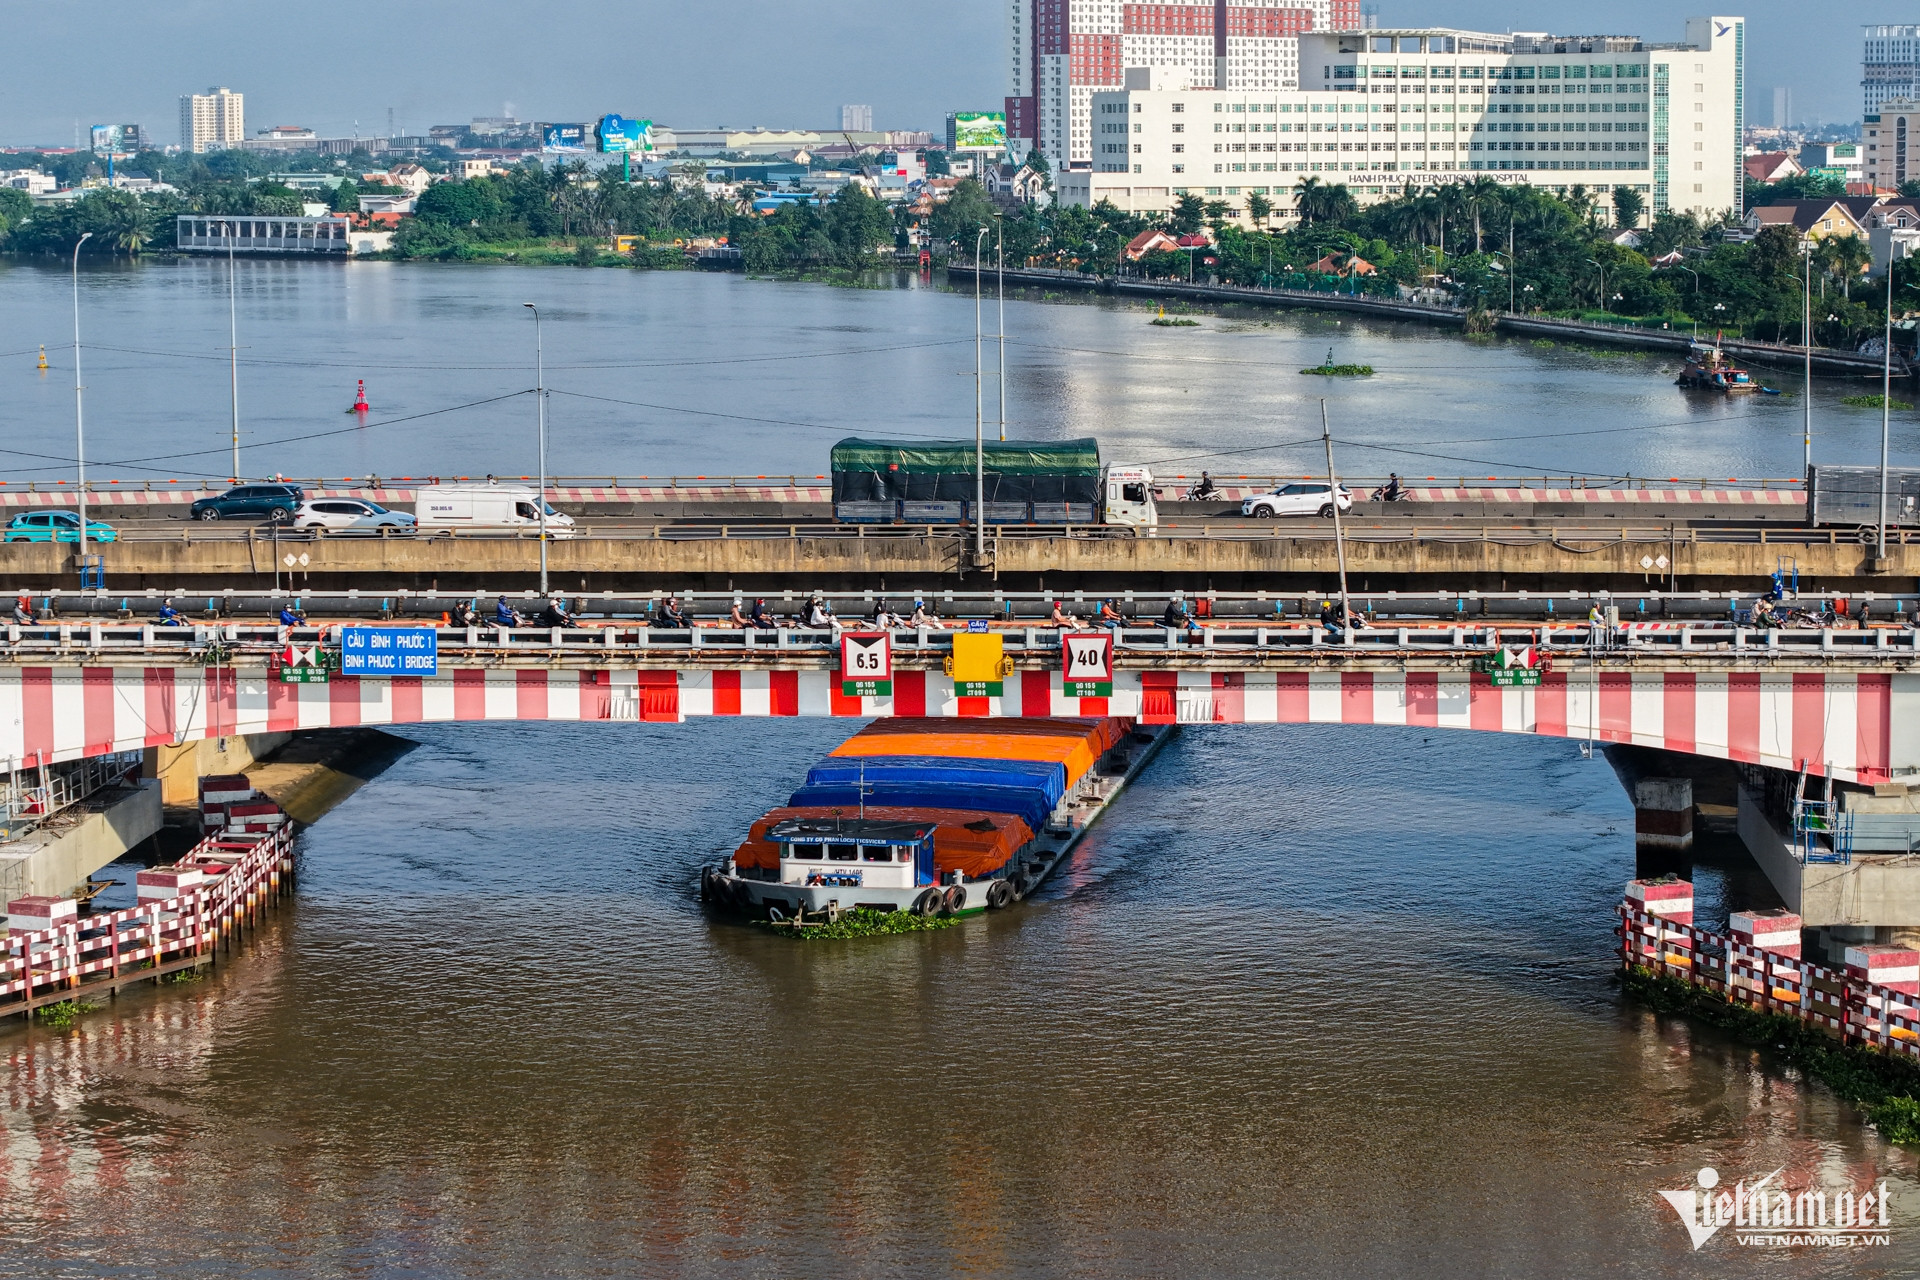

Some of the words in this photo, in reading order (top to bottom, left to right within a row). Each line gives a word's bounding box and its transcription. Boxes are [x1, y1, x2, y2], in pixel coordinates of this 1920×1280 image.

[1349, 175, 1377, 183] HANH
[1378, 175, 1406, 183] PHUC
[347, 630, 365, 648] CẦU
[371, 631, 391, 648] BÌNH
[396, 631, 425, 649] PHƯỚC
[427, 636, 432, 649] 1
[345, 655, 364, 668] BINH
[367, 655, 395, 668] PHUOC
[398, 655, 402, 668] 1
[405, 655, 434, 669] BRIDGE
[856, 652, 879, 670] 6.5
[1077, 649, 1098, 666] 40
